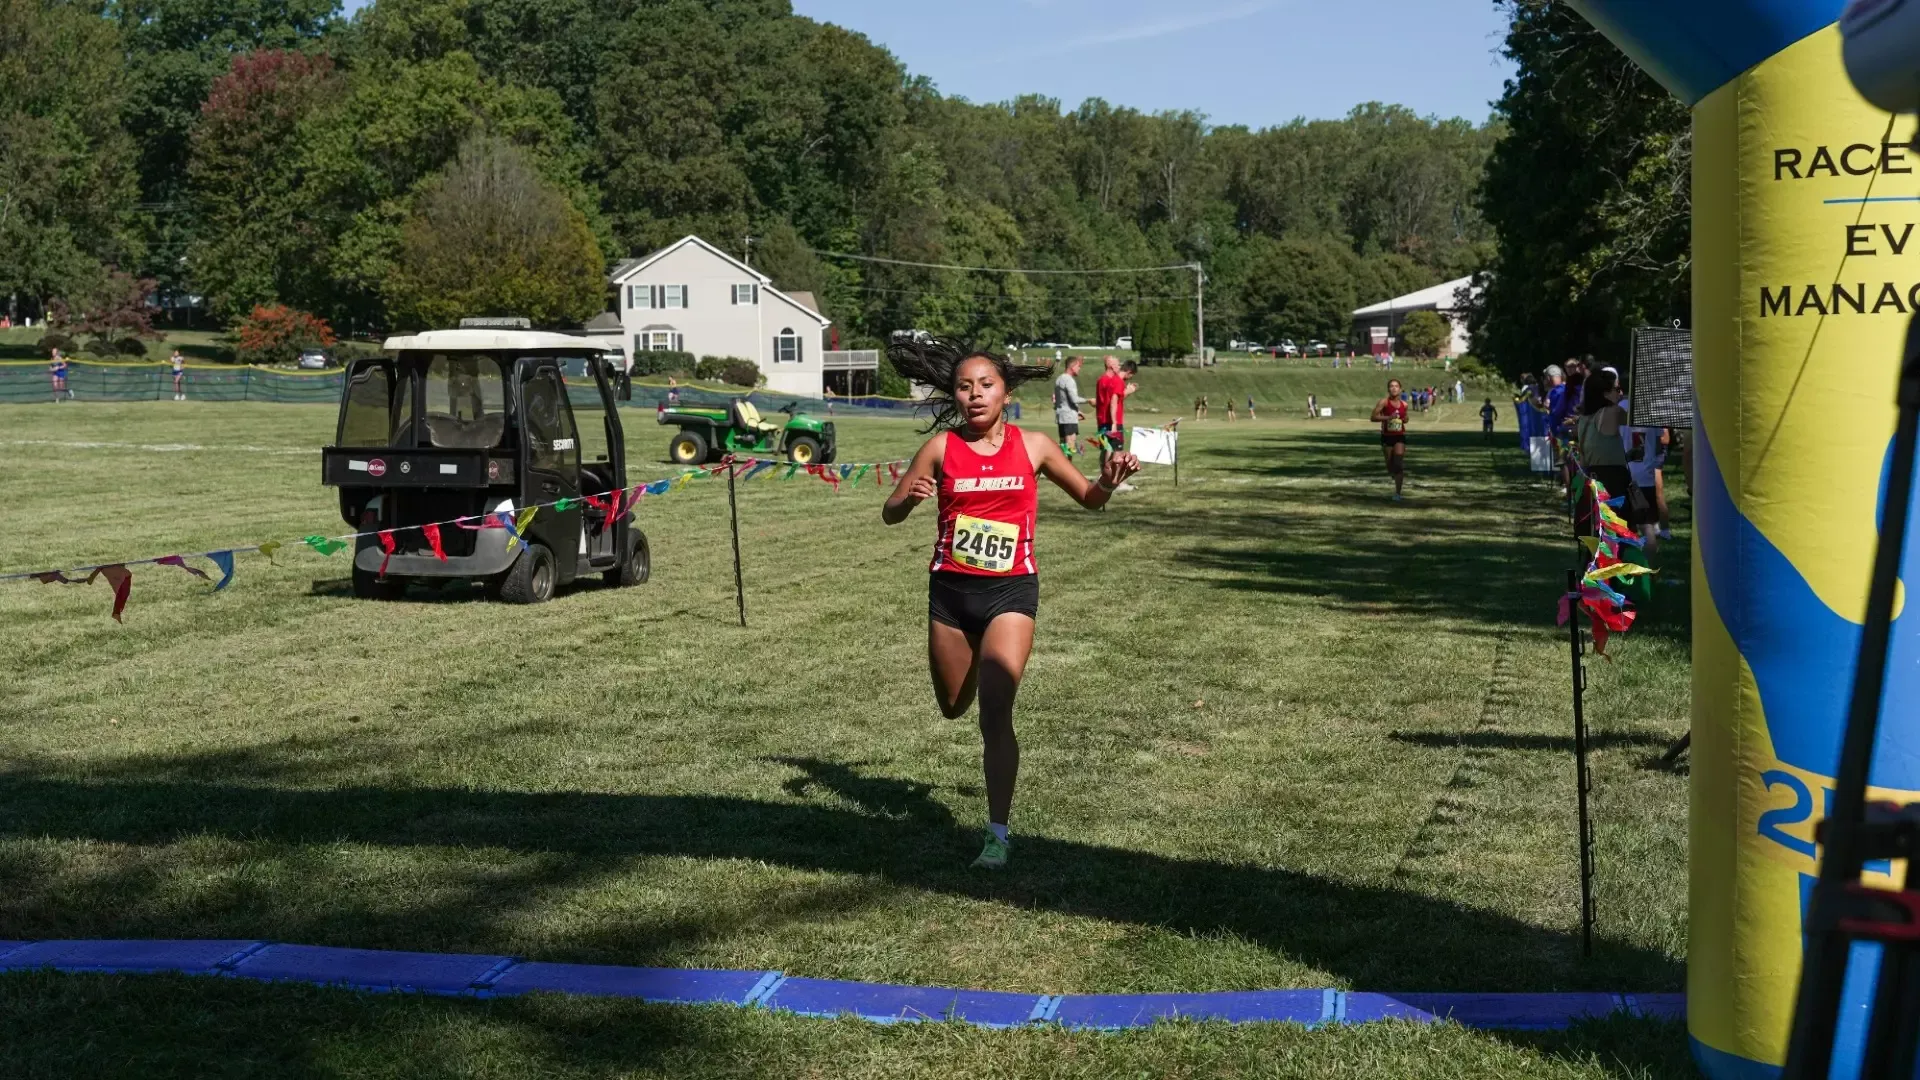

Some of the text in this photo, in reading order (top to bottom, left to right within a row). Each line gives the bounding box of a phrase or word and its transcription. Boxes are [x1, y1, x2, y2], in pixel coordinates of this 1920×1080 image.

[1773, 142, 1914, 181] RACE
[1845, 223, 1920, 257] EV
[553, 438, 574, 451] SECURITY
[955, 528, 1015, 560] 2465
